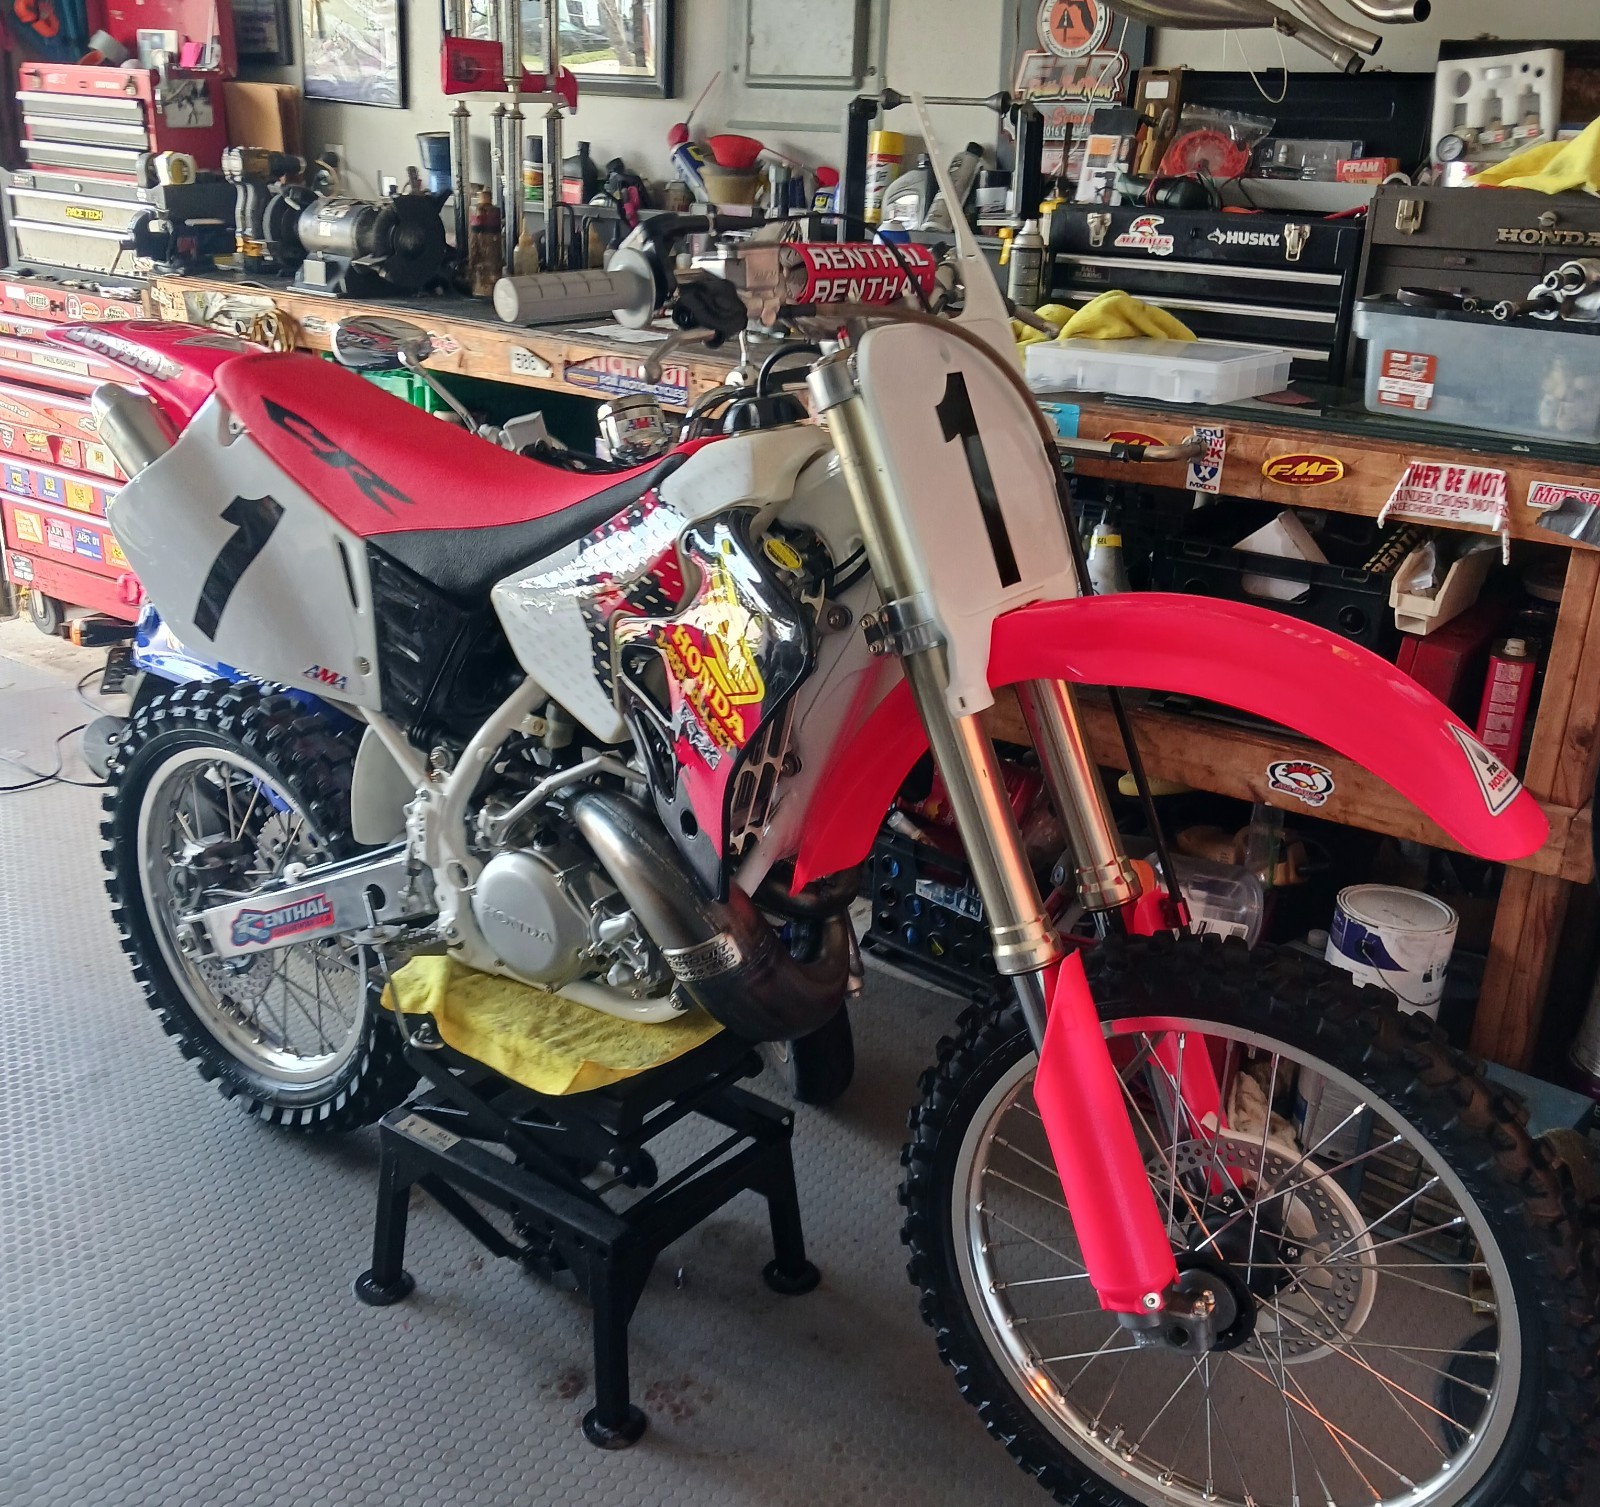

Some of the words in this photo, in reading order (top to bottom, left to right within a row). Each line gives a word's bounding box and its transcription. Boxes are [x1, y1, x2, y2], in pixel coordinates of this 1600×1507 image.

[1342, 161, 1379, 173] FRAM
[66, 206, 84, 219] RACE
[84, 208, 103, 220] TECH
[1226, 230, 1280, 247] HUSKY
[1496, 228, 1600, 247] HONDA
[807, 247, 929, 270] RENTHAL
[625, 415, 658, 432] AMA
[261, 396, 416, 518] CR
[1268, 461, 1339, 476] FMF
[935, 371, 1022, 589] 1
[1444, 467, 1466, 493] BE
[1435, 493, 1470, 509] CROSS
[302, 664, 348, 691] AMA
[672, 624, 747, 744] HONDA
[232, 897, 331, 943] RENTHAL
